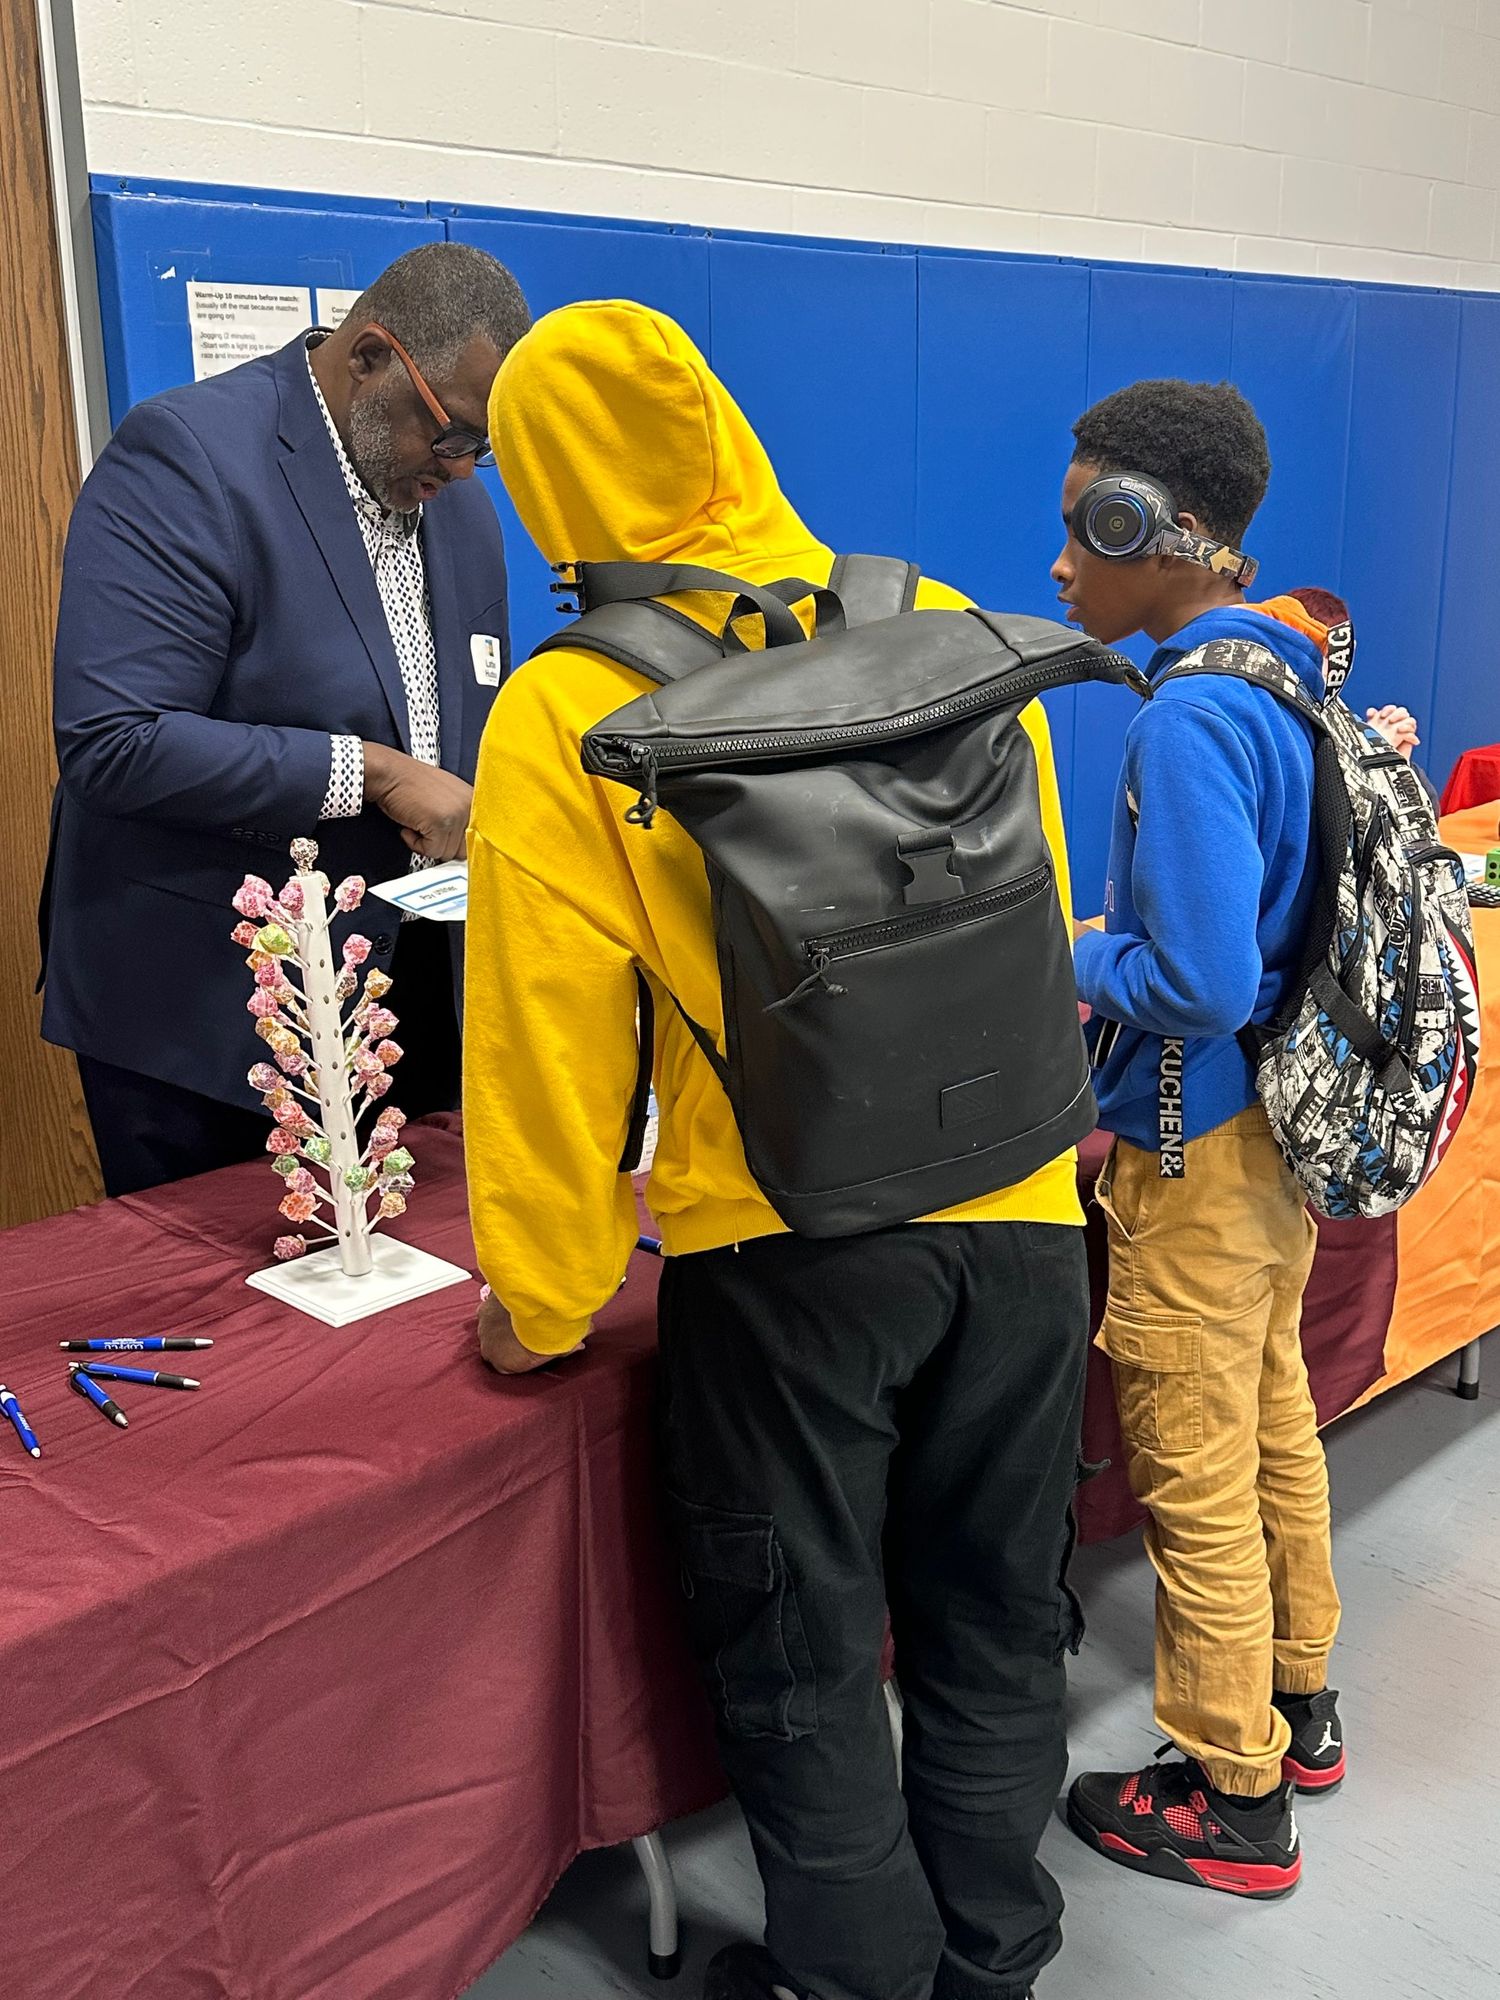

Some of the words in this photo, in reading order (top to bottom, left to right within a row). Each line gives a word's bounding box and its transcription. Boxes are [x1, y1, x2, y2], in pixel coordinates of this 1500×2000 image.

[194, 291, 224, 300] Warm-Up
[250, 303, 274, 311] because
[208, 312, 224, 320] going
